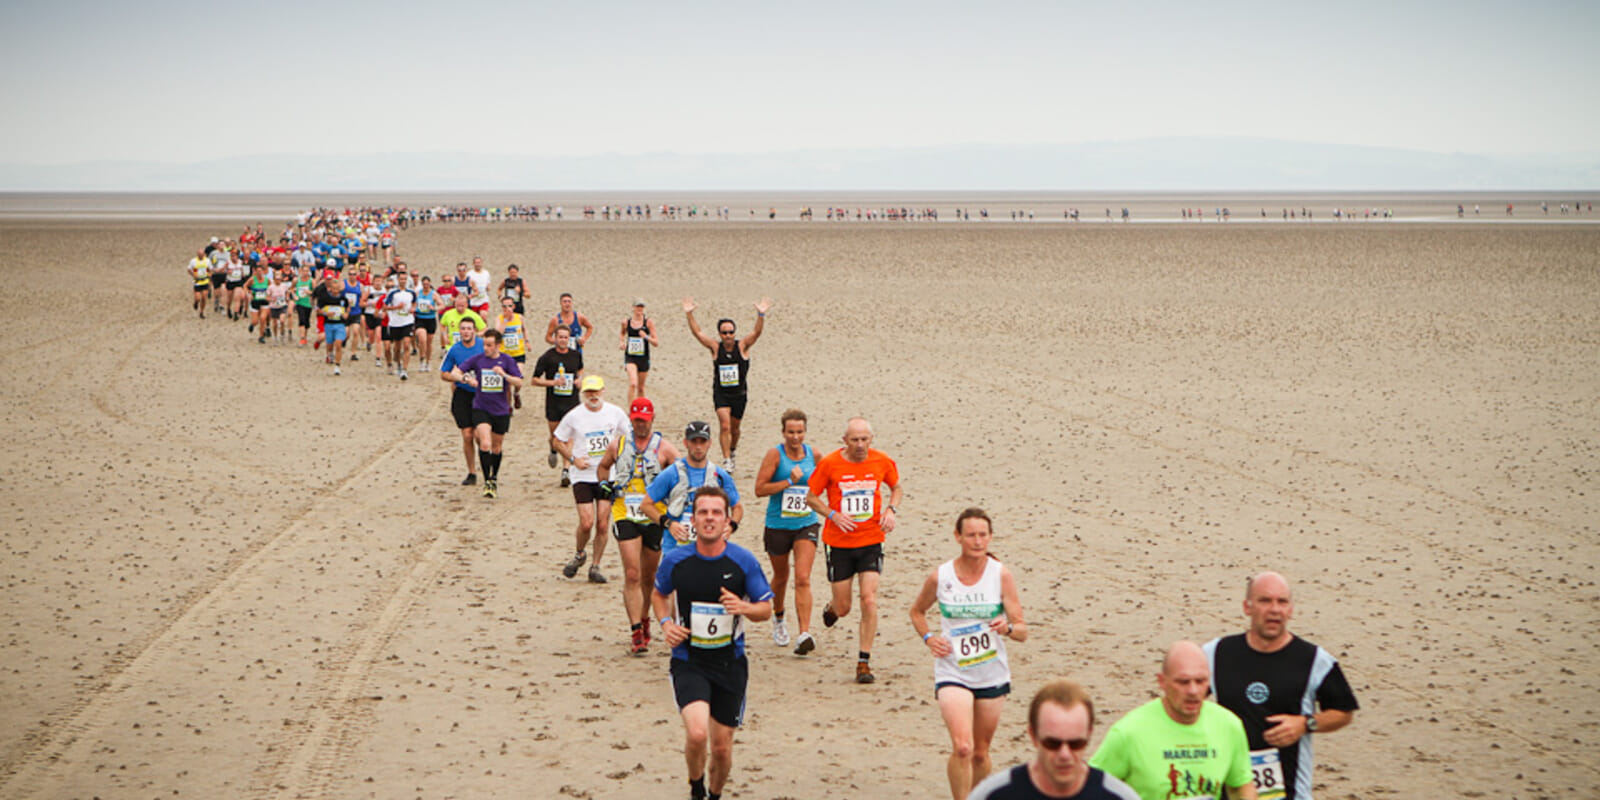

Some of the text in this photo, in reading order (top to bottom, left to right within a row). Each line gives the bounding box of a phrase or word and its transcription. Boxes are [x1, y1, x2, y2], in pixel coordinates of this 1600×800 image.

[484, 376, 501, 386] 509
[589, 436, 609, 451] 550
[846, 498, 869, 512] 118
[953, 593, 988, 602] GAIL
[707, 618, 718, 636] 6
[960, 633, 990, 656] 690
[1163, 749, 1208, 759] MARLOW
